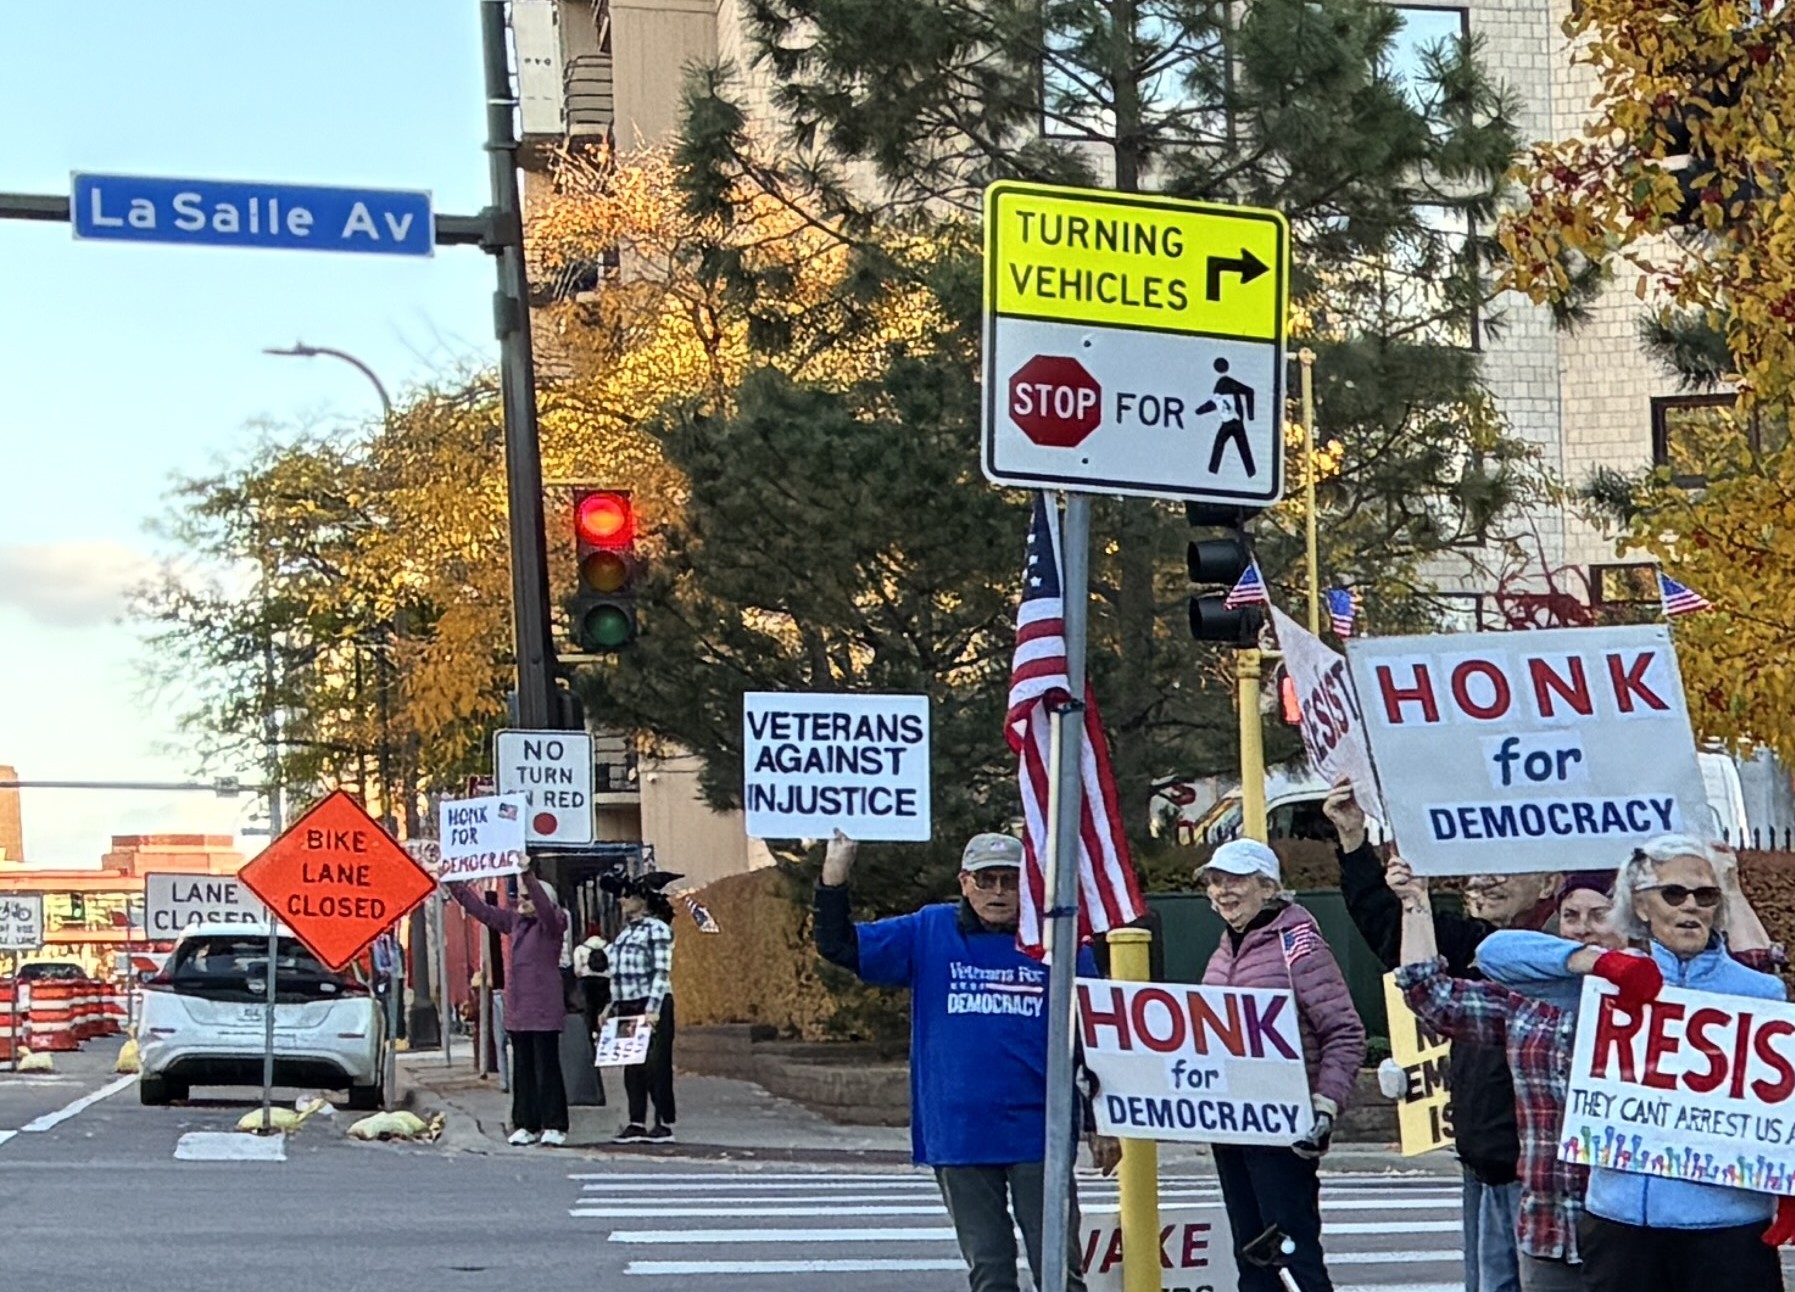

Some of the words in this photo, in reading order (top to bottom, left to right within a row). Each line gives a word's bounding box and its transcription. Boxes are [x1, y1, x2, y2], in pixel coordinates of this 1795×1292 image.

[91, 187, 156, 229] La
[172, 191, 314, 237] Salle
[341, 201, 414, 242] Av
[1015, 209, 1184, 259] TURNING
[1009, 262, 1188, 311] VEHICLES
[1013, 381, 1097, 421] STOP
[1115, 391, 1185, 430] FOR
[1375, 651, 1672, 725] HONK
[746, 710, 924, 744] VETERANS
[523, 739, 564, 762] NO
[753, 742, 908, 776] AGAINST
[1493, 736, 1583, 787] for
[516, 765, 573, 785] TURN
[543, 791, 585, 809] RED
[747, 782, 918, 817] INJUSTICE
[448, 805, 488, 827] HONK
[1429, 797, 1674, 841] DEMOCRACY
[307, 828, 369, 853] BIKE
[451, 827, 479, 846] FOR
[302, 862, 372, 887] LANE
[441, 849, 519, 876] DEMOCRAC
[171, 881, 239, 905] LANE
[286, 893, 386, 920] CLOSED
[949, 961, 1015, 983] Veterans
[947, 992, 1044, 1018] DEMOCRACY
[1076, 984, 1300, 1061] HONK
[1171, 1058, 1220, 1089] for
[1106, 1094, 1300, 1135] DEMOCRACY
[1572, 1088, 1618, 1119] THEY
[1674, 1105, 1752, 1139] ARREST
[1755, 1113, 1783, 1144] US
